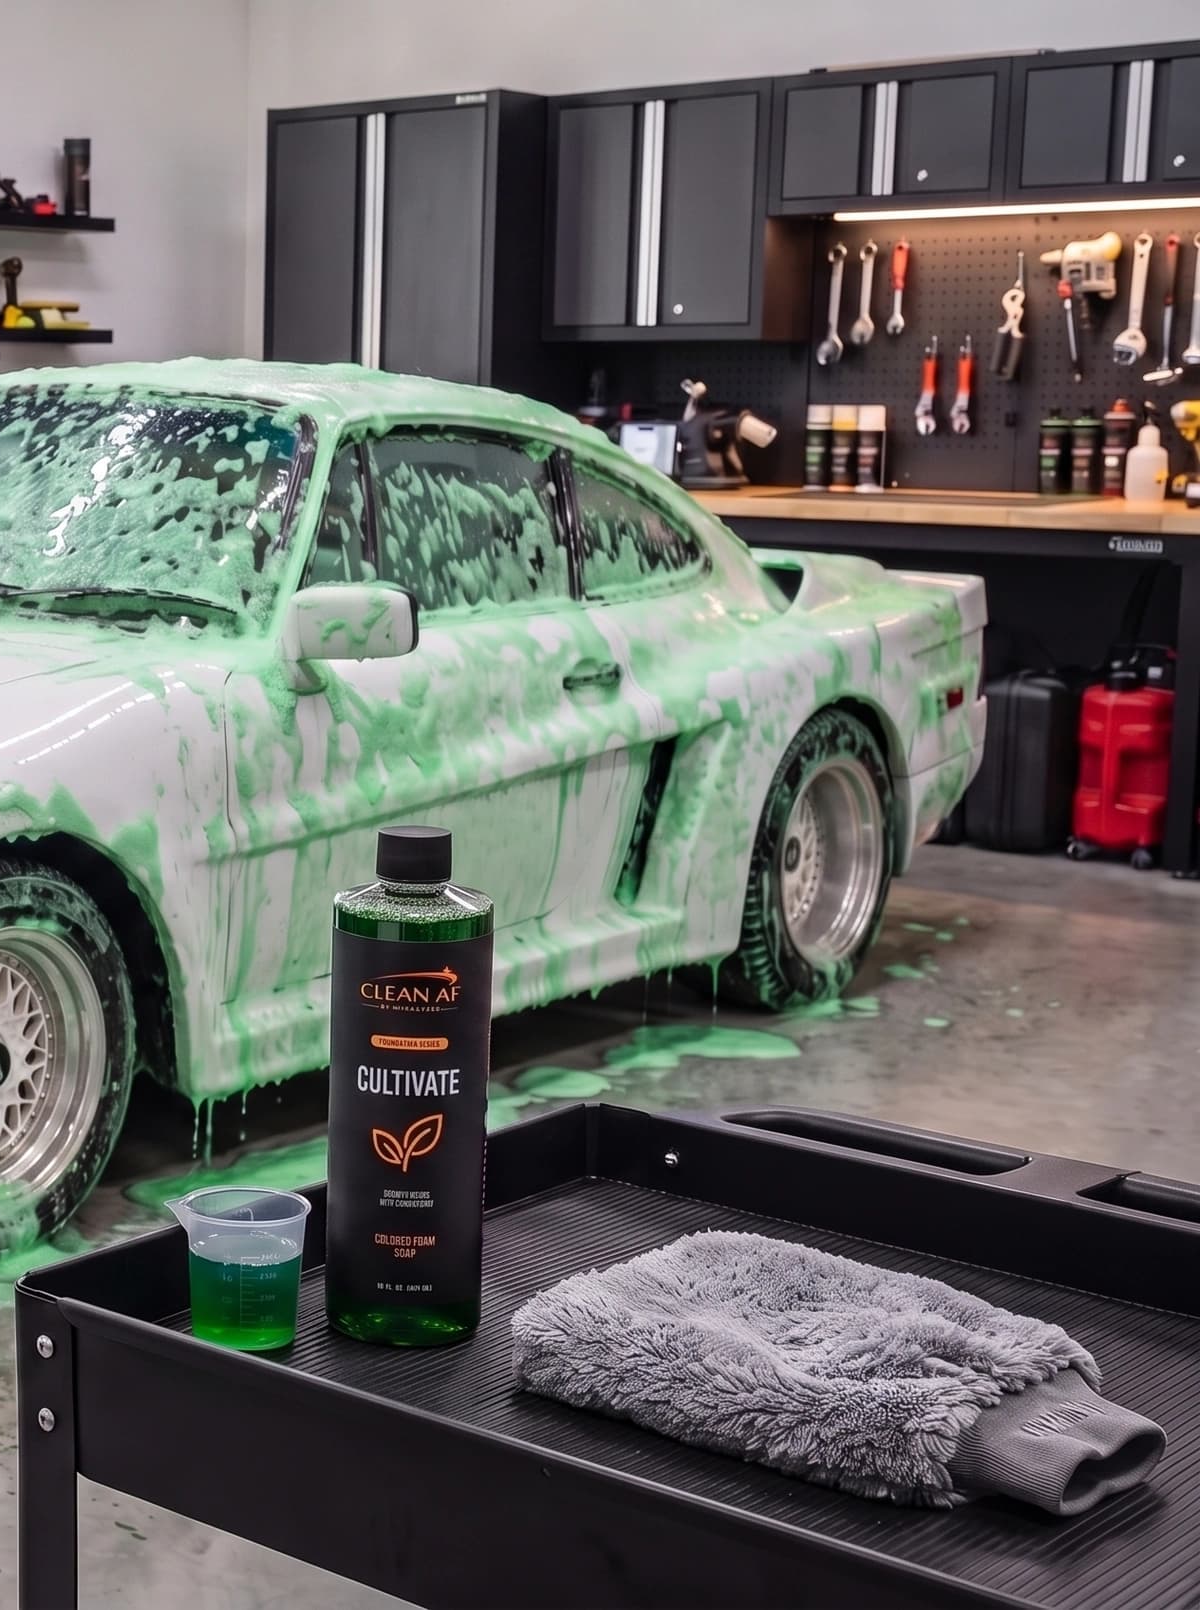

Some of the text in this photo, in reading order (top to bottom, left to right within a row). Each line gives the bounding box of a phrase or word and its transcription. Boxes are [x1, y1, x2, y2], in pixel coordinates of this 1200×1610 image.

[360, 983, 461, 1003] CLEAN AF
[357, 1064, 460, 1097] CULTIVATE
[374, 1233, 436, 1247] COLORED FOAM
[394, 1248, 416, 1258] SOAP
